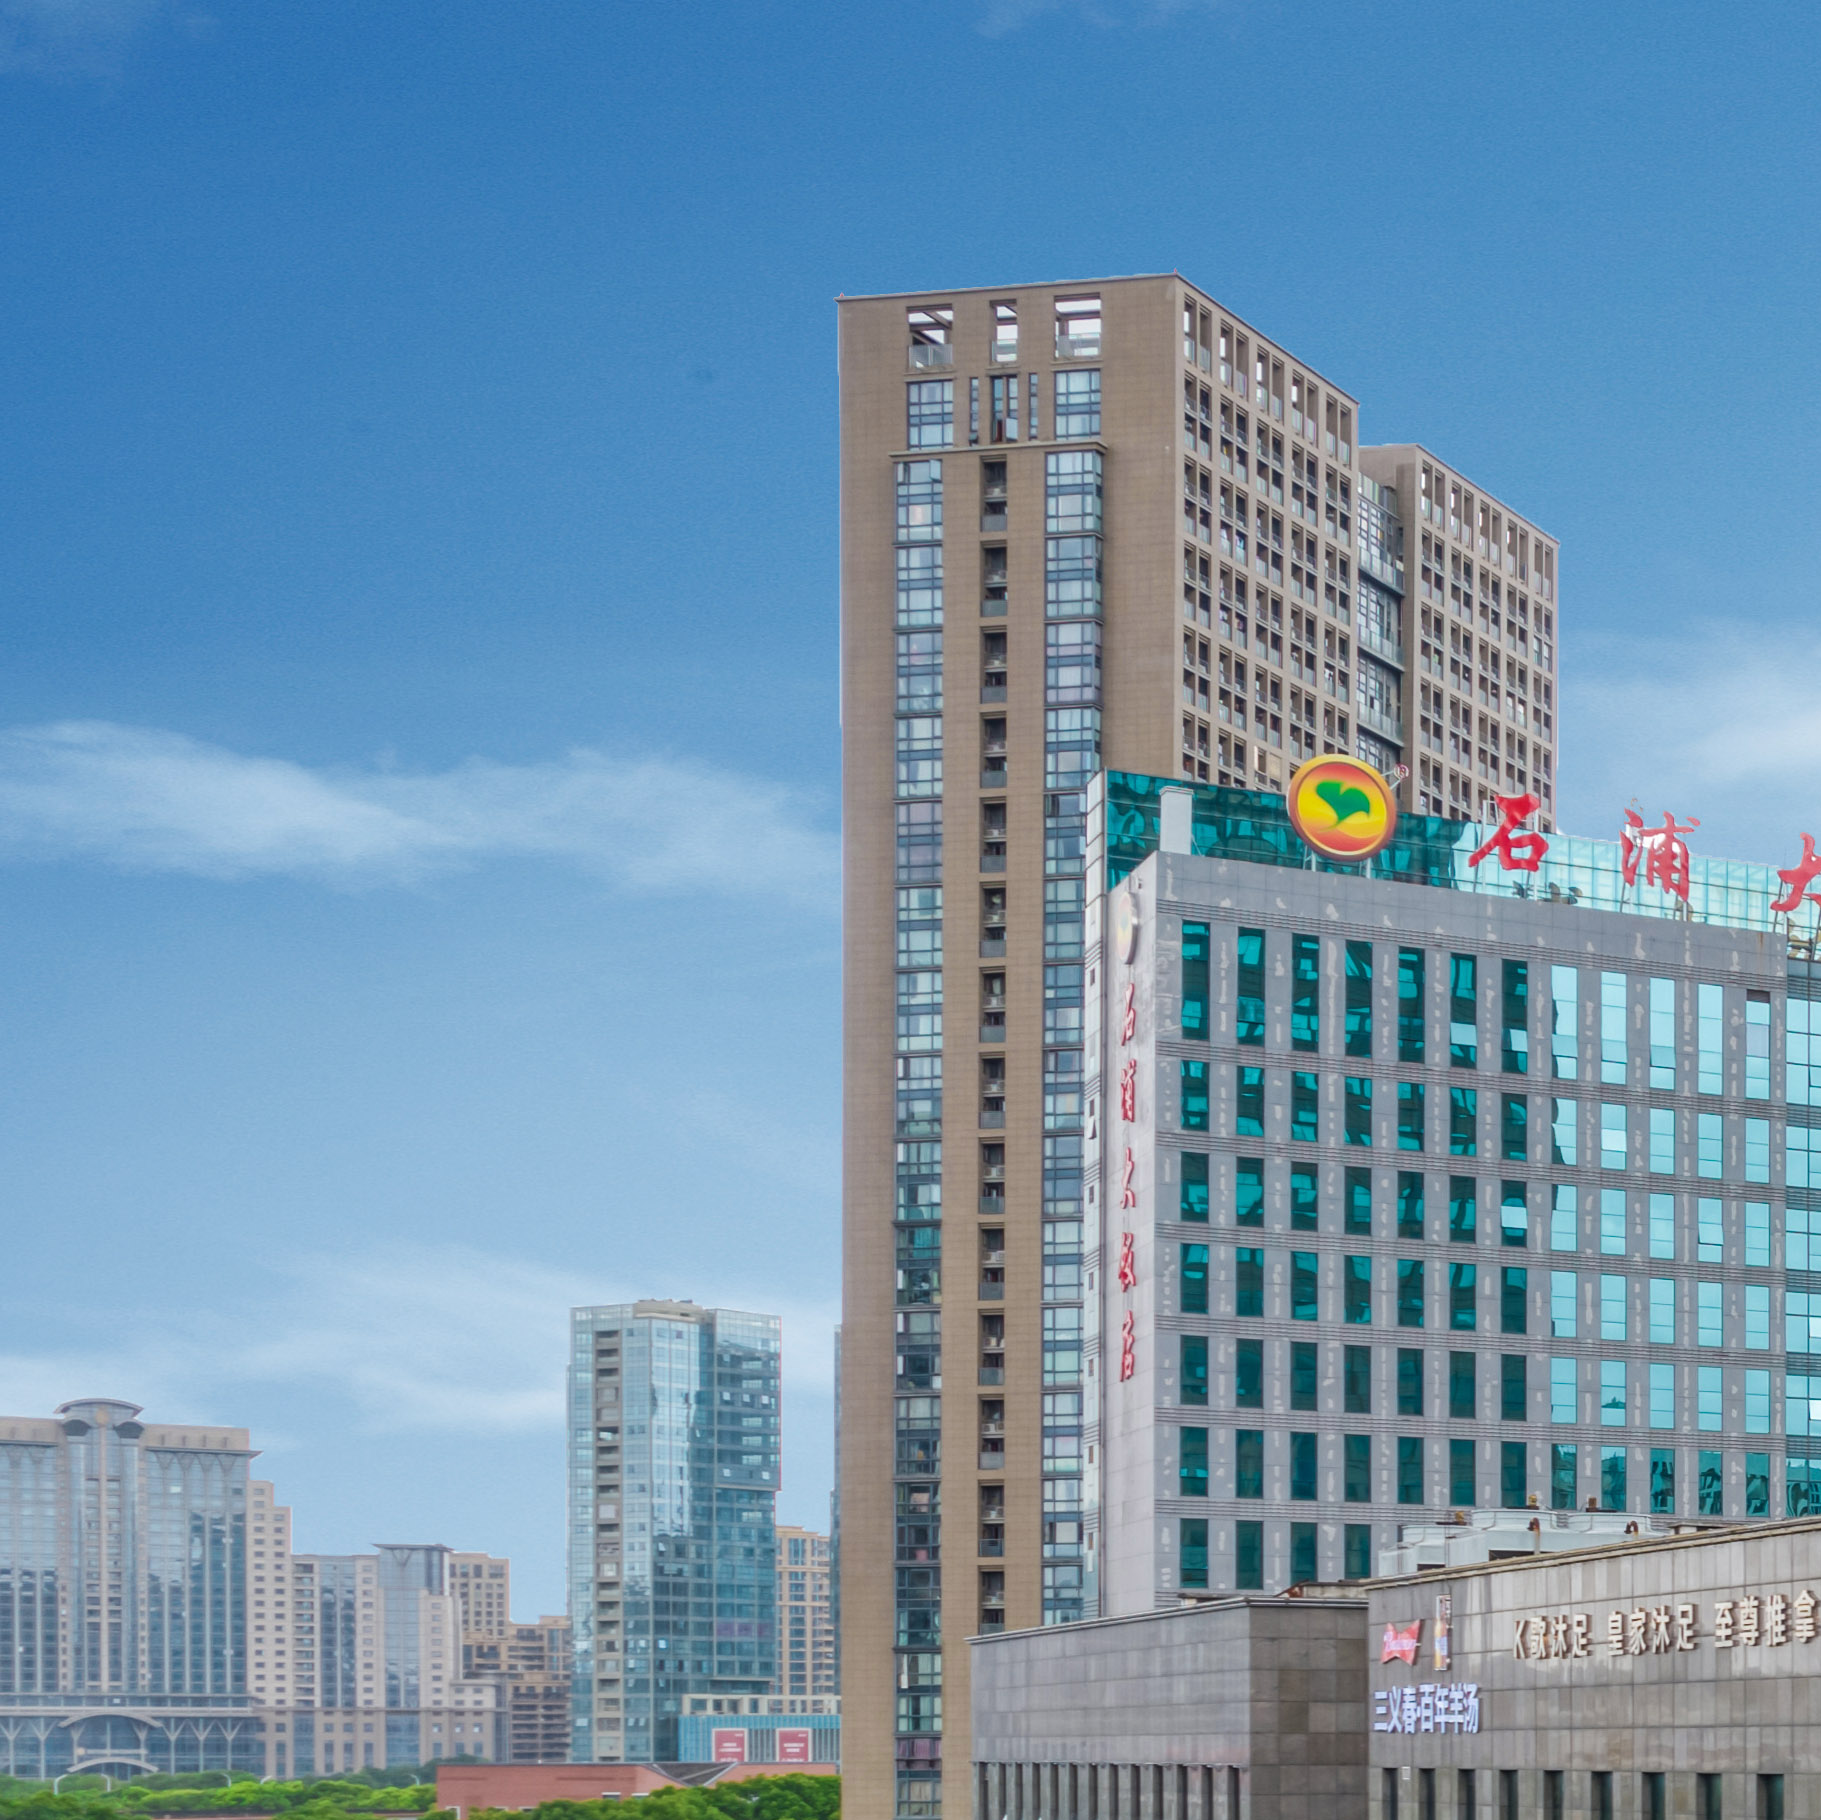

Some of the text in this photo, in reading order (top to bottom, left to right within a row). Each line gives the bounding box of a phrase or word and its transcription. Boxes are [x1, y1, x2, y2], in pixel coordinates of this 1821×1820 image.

[1513, 1590, 1818, 1660] K歌沐足 皇家沐足 至尊推拿
